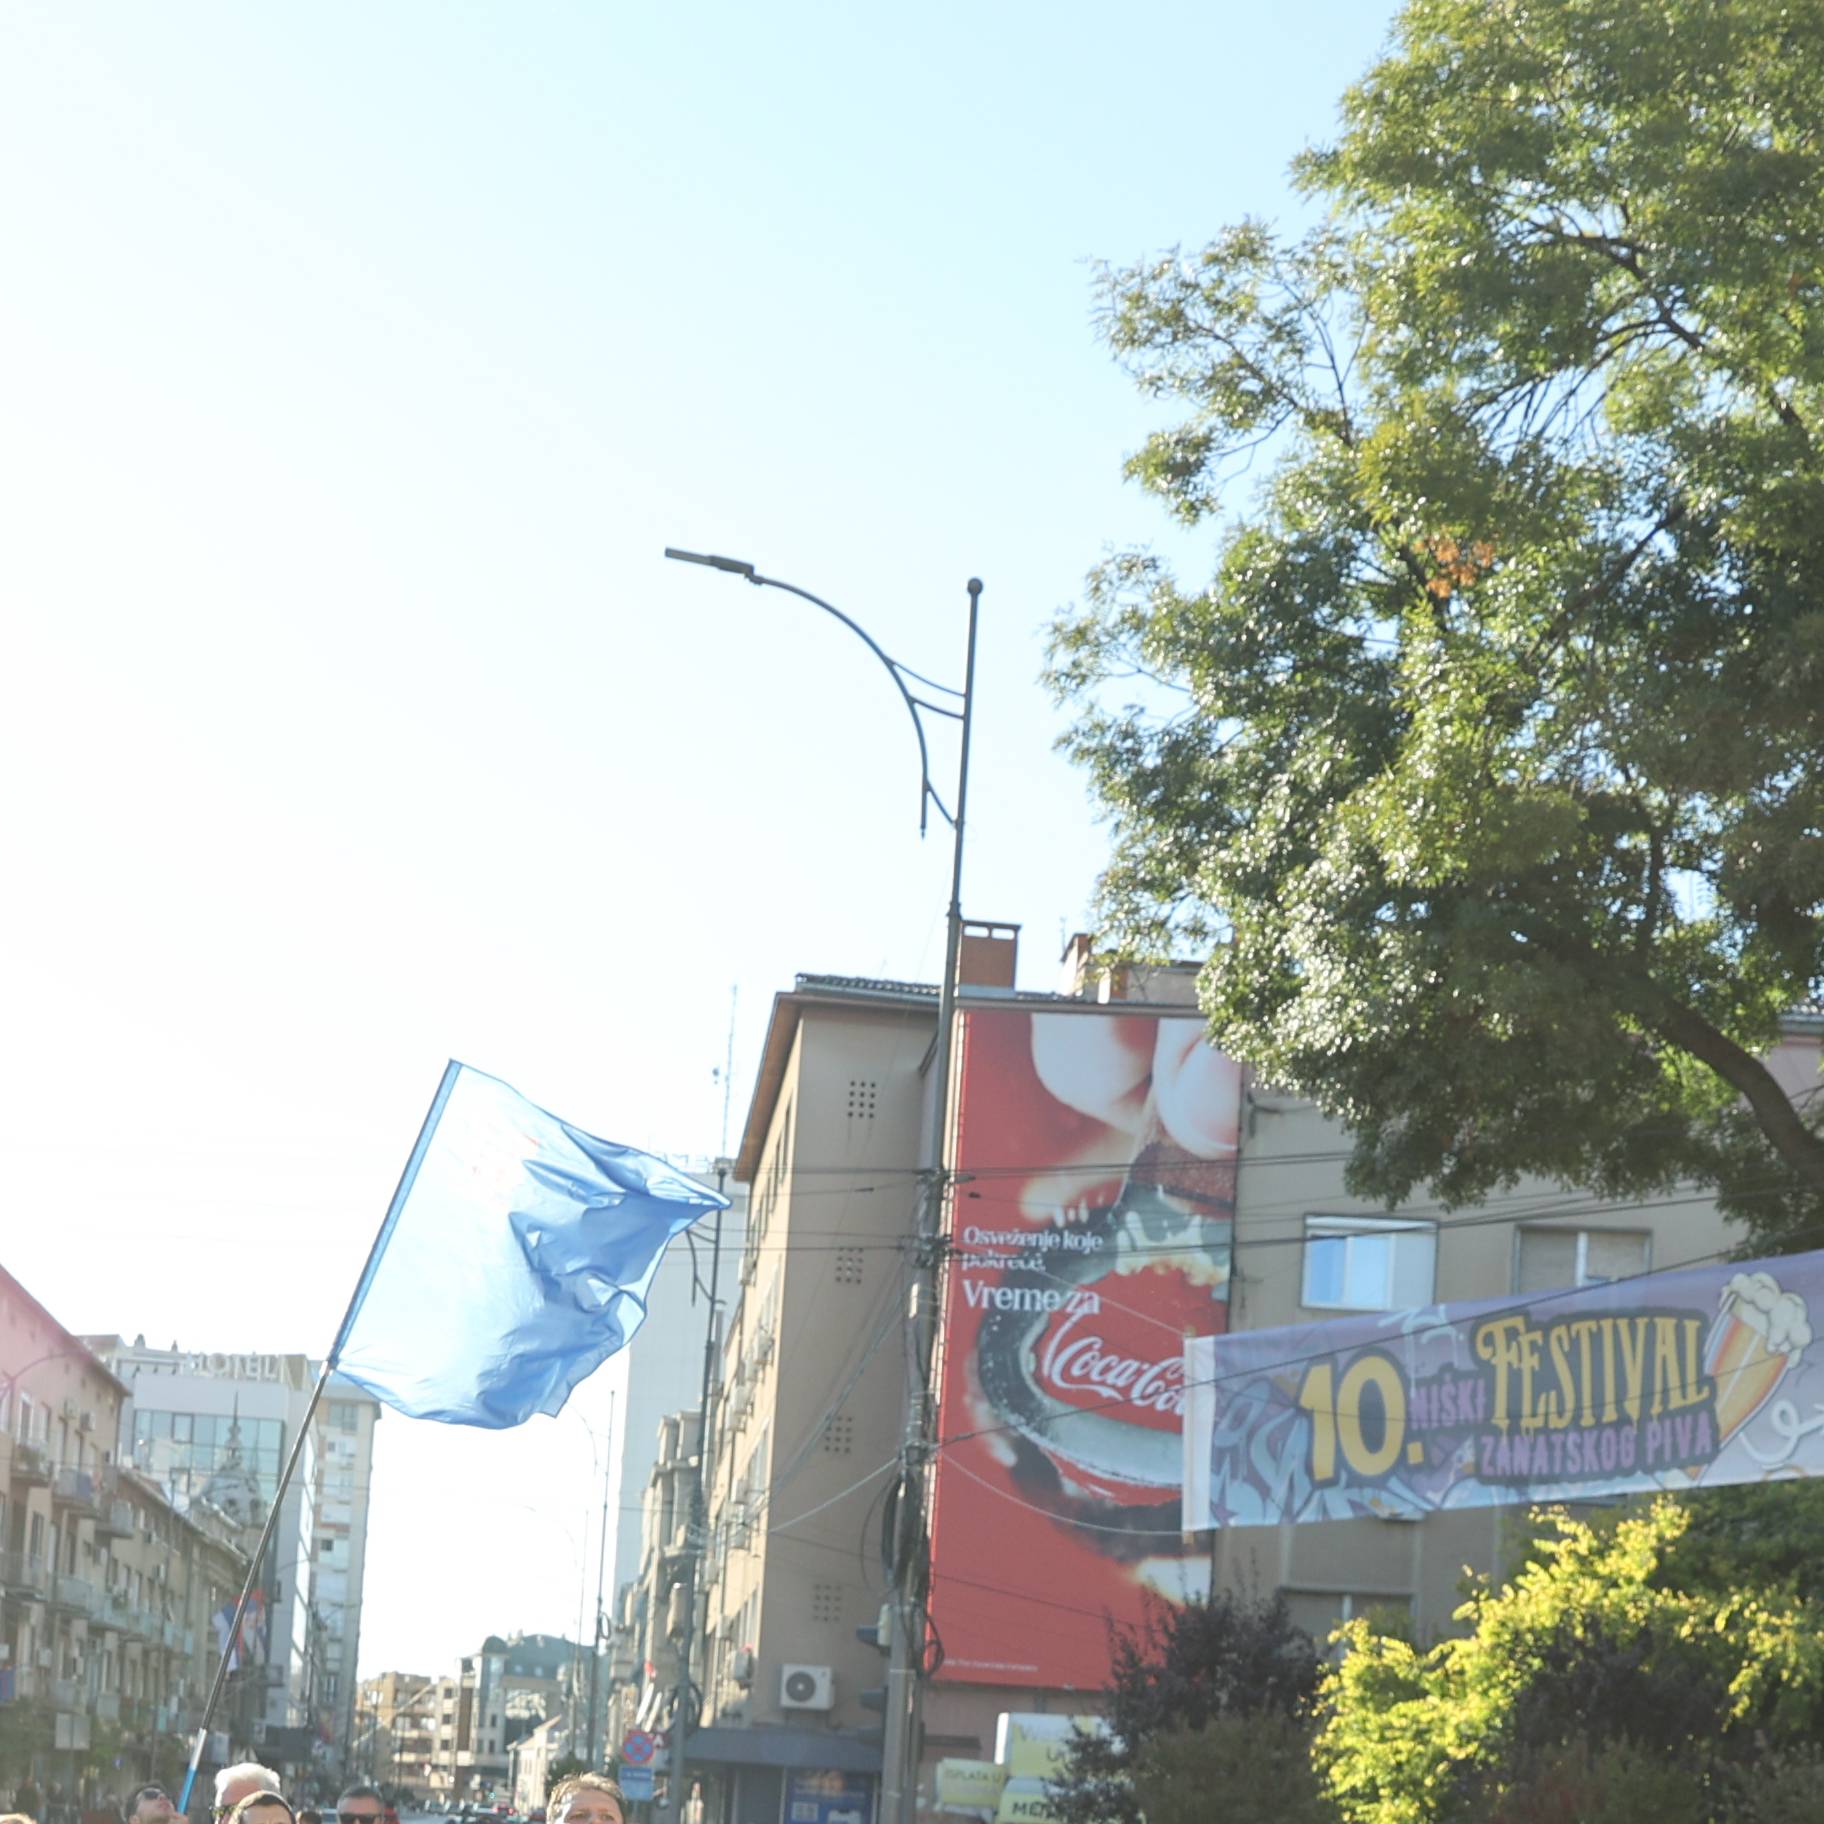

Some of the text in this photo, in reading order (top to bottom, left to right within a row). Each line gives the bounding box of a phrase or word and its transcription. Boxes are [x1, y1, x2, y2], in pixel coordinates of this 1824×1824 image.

[1062, 1230, 1104, 1254] koje
[962, 1279, 1101, 1314] Vreme za
[1299, 1355, 1425, 1481] 10.
[1409, 1374, 1486, 1431] NIŠKI
[1481, 1410, 1712, 1476] ZANATSKOG PIVA
